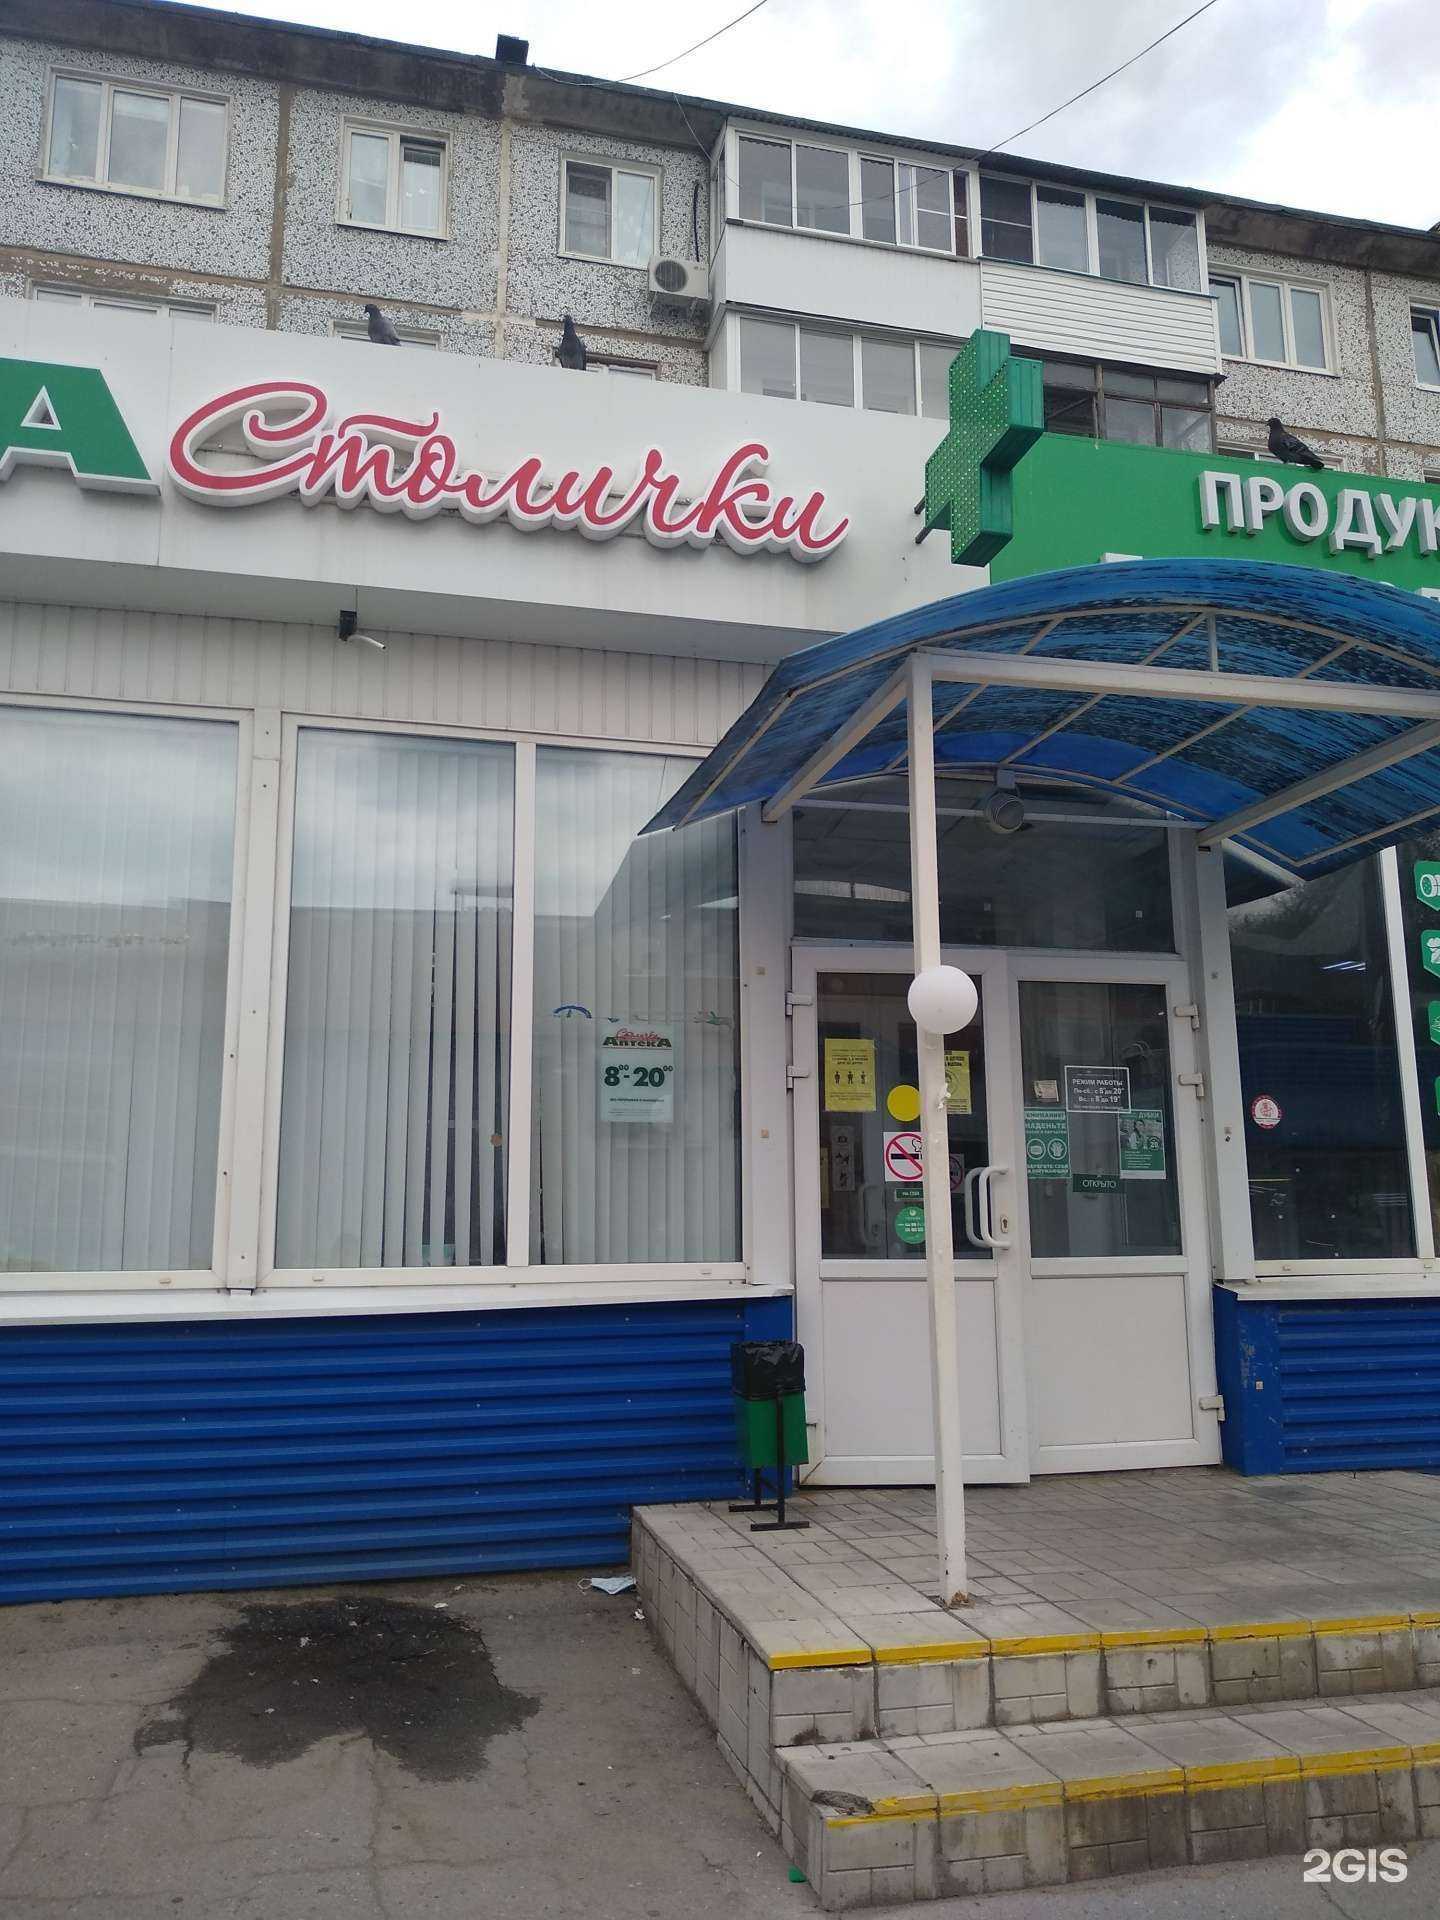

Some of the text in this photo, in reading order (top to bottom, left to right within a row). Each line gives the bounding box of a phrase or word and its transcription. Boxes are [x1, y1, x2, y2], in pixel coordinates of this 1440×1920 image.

[168, 379, 851, 558] Столички
[1072, 1078, 1096, 1086] РЕЖИМ
[1082, 1179, 1117, 1189] ОТКРЫТО
